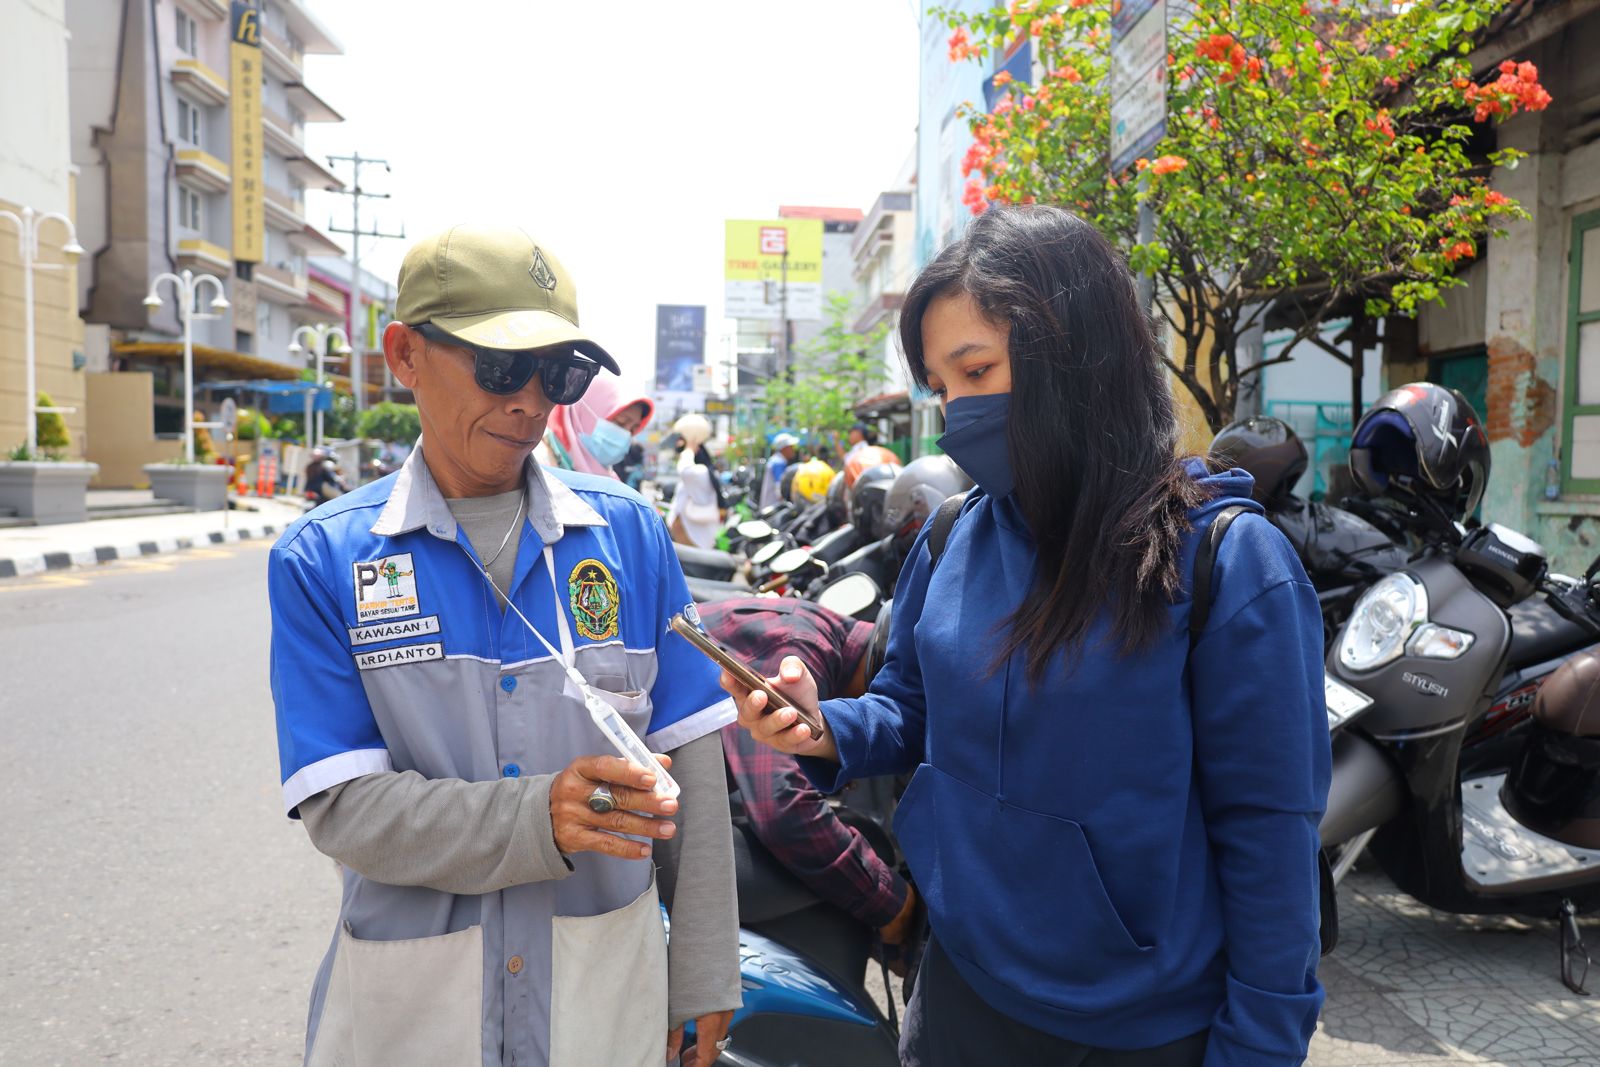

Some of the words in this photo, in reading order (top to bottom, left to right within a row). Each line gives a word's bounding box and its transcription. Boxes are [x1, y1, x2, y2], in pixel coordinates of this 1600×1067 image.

[1488, 545, 1519, 565] HONDA
[357, 564, 378, 601] P
[360, 609, 379, 618] BAYAR
[380, 607, 400, 616] SESUAI
[356, 623, 420, 641] KAWASAN
[361, 647, 436, 666] ARDIANTO
[1402, 671, 1449, 698] STYLISH
